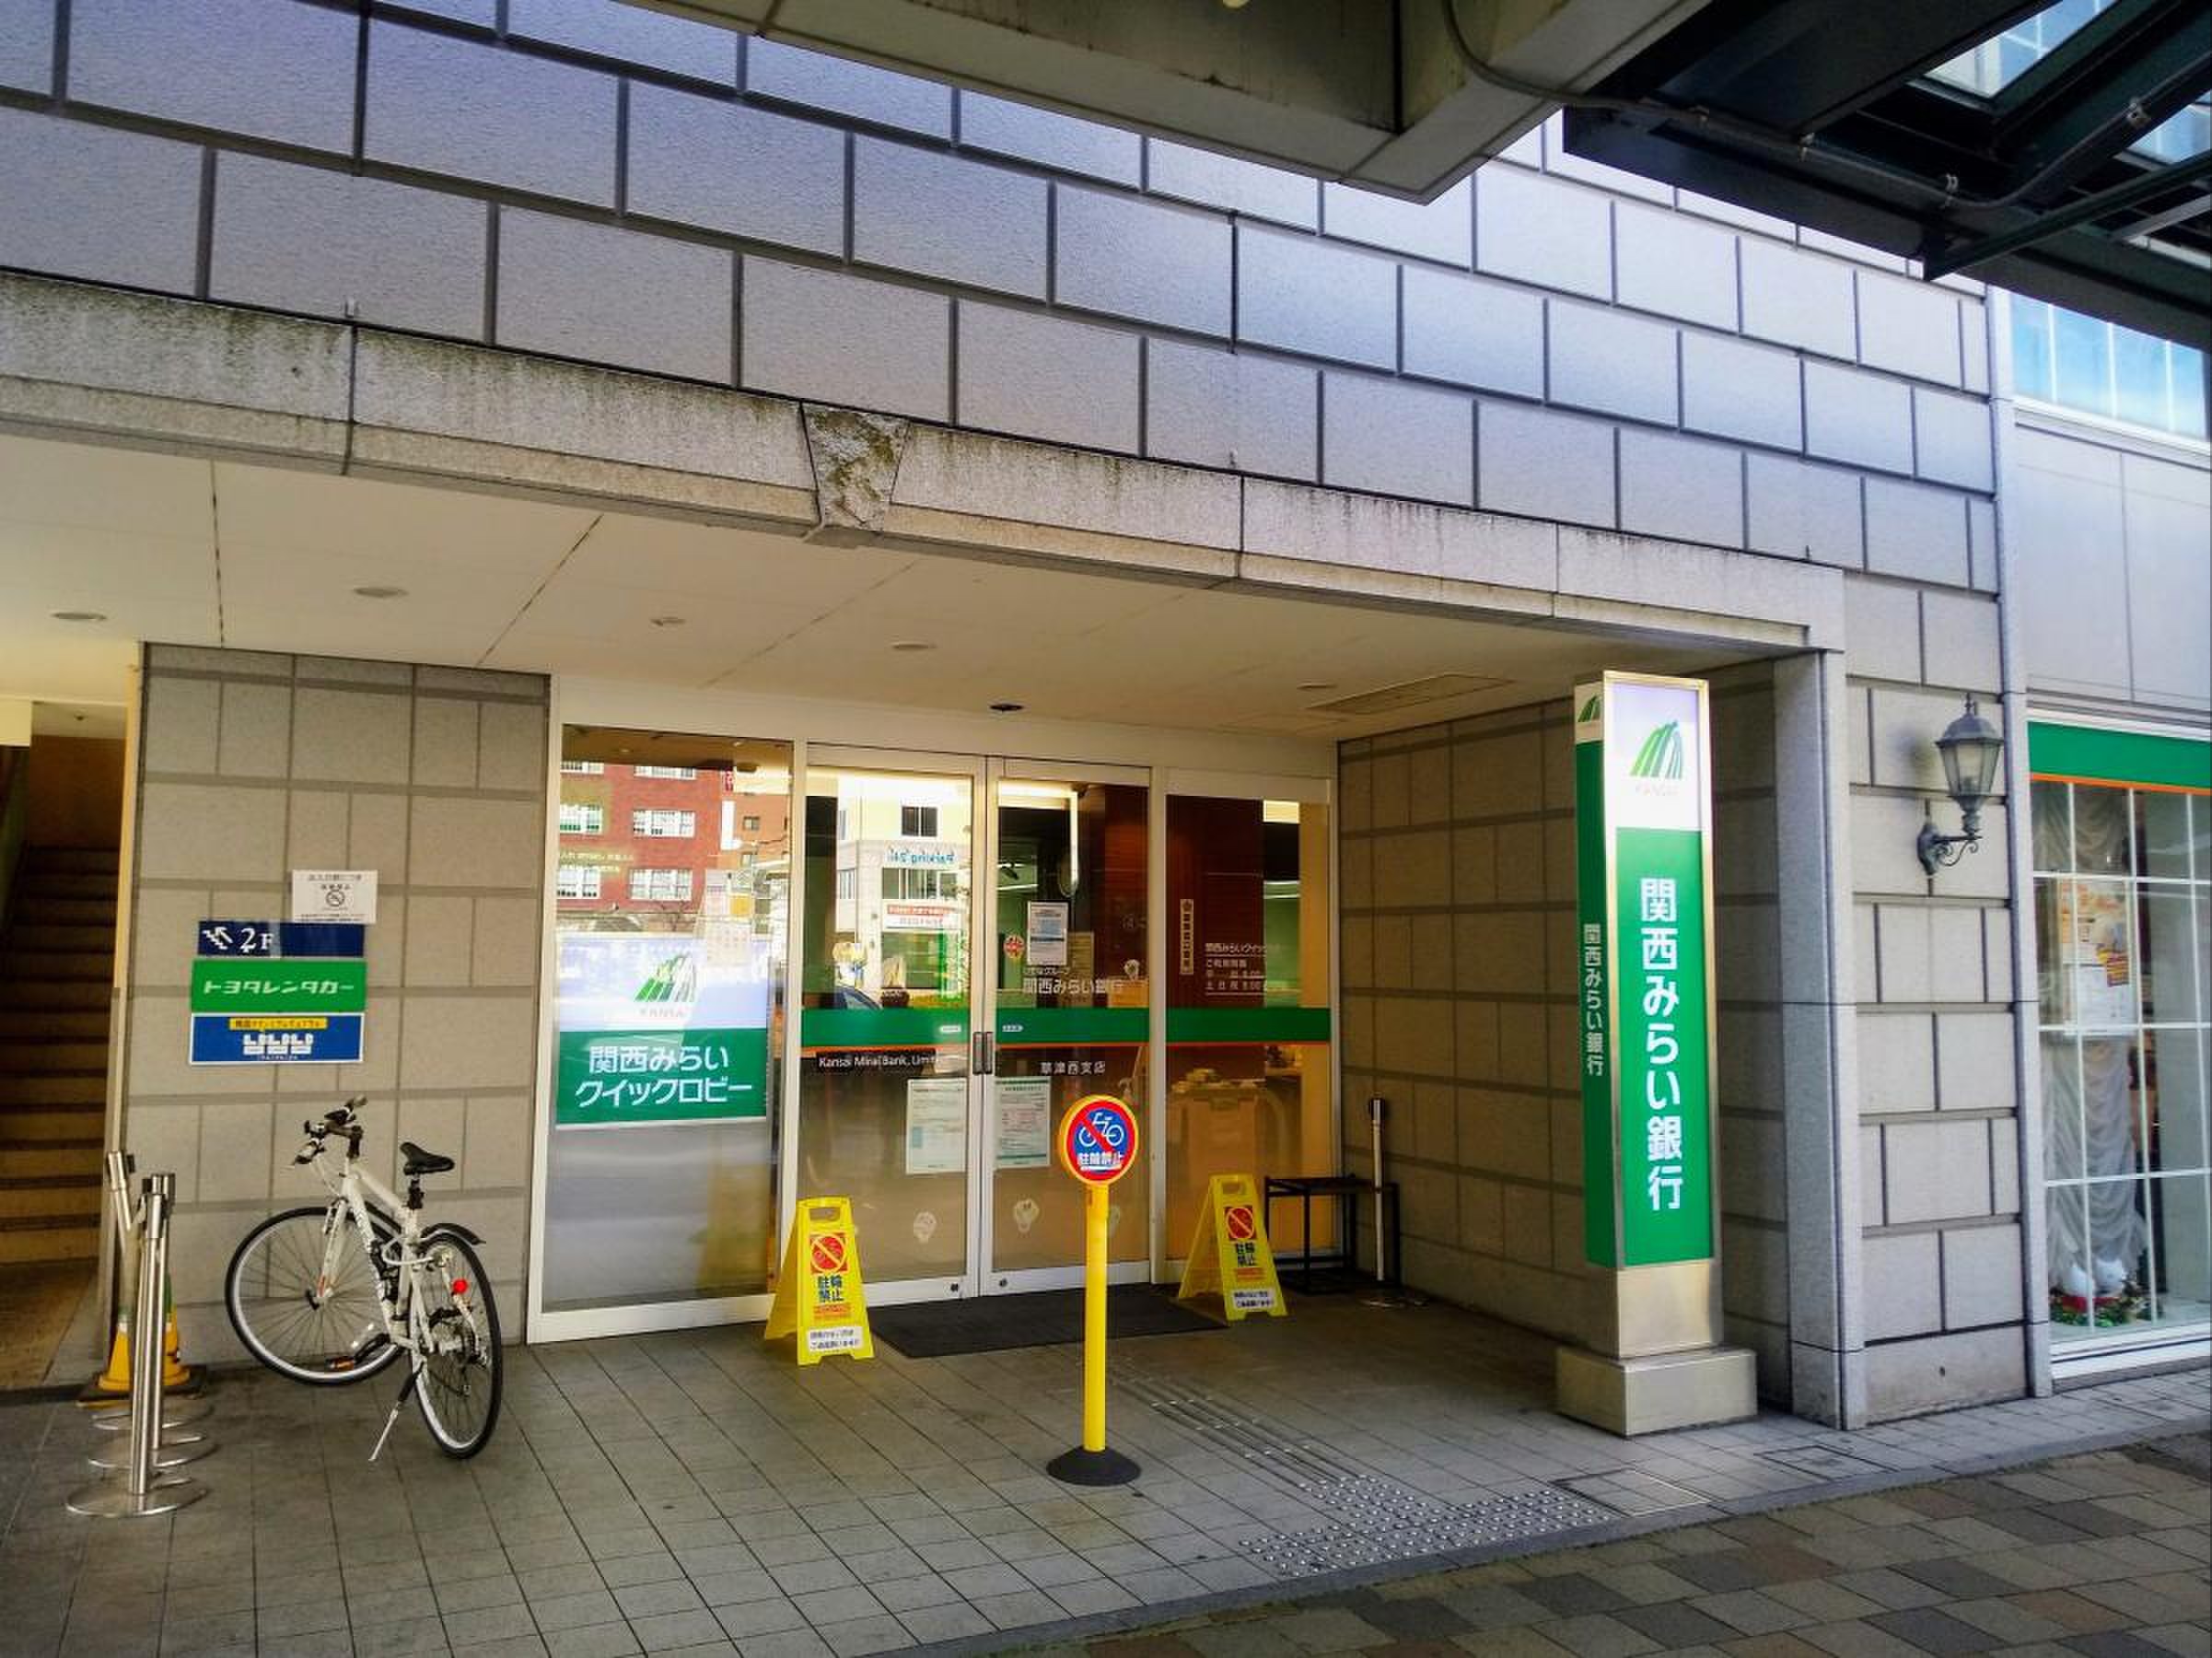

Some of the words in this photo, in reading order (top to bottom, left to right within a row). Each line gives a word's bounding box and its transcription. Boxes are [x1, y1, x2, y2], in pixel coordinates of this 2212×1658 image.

[239, 928, 274, 953] 2F
[203, 980, 355, 995] トヨタレンタカー
[1583, 923, 1604, 1077] 関西みらい銀行
[1638, 877, 1684, 1211] 関西みらい銀行
[588, 1045, 729, 1074] 関西みらい
[575, 1076, 752, 1107] クイックロビー
